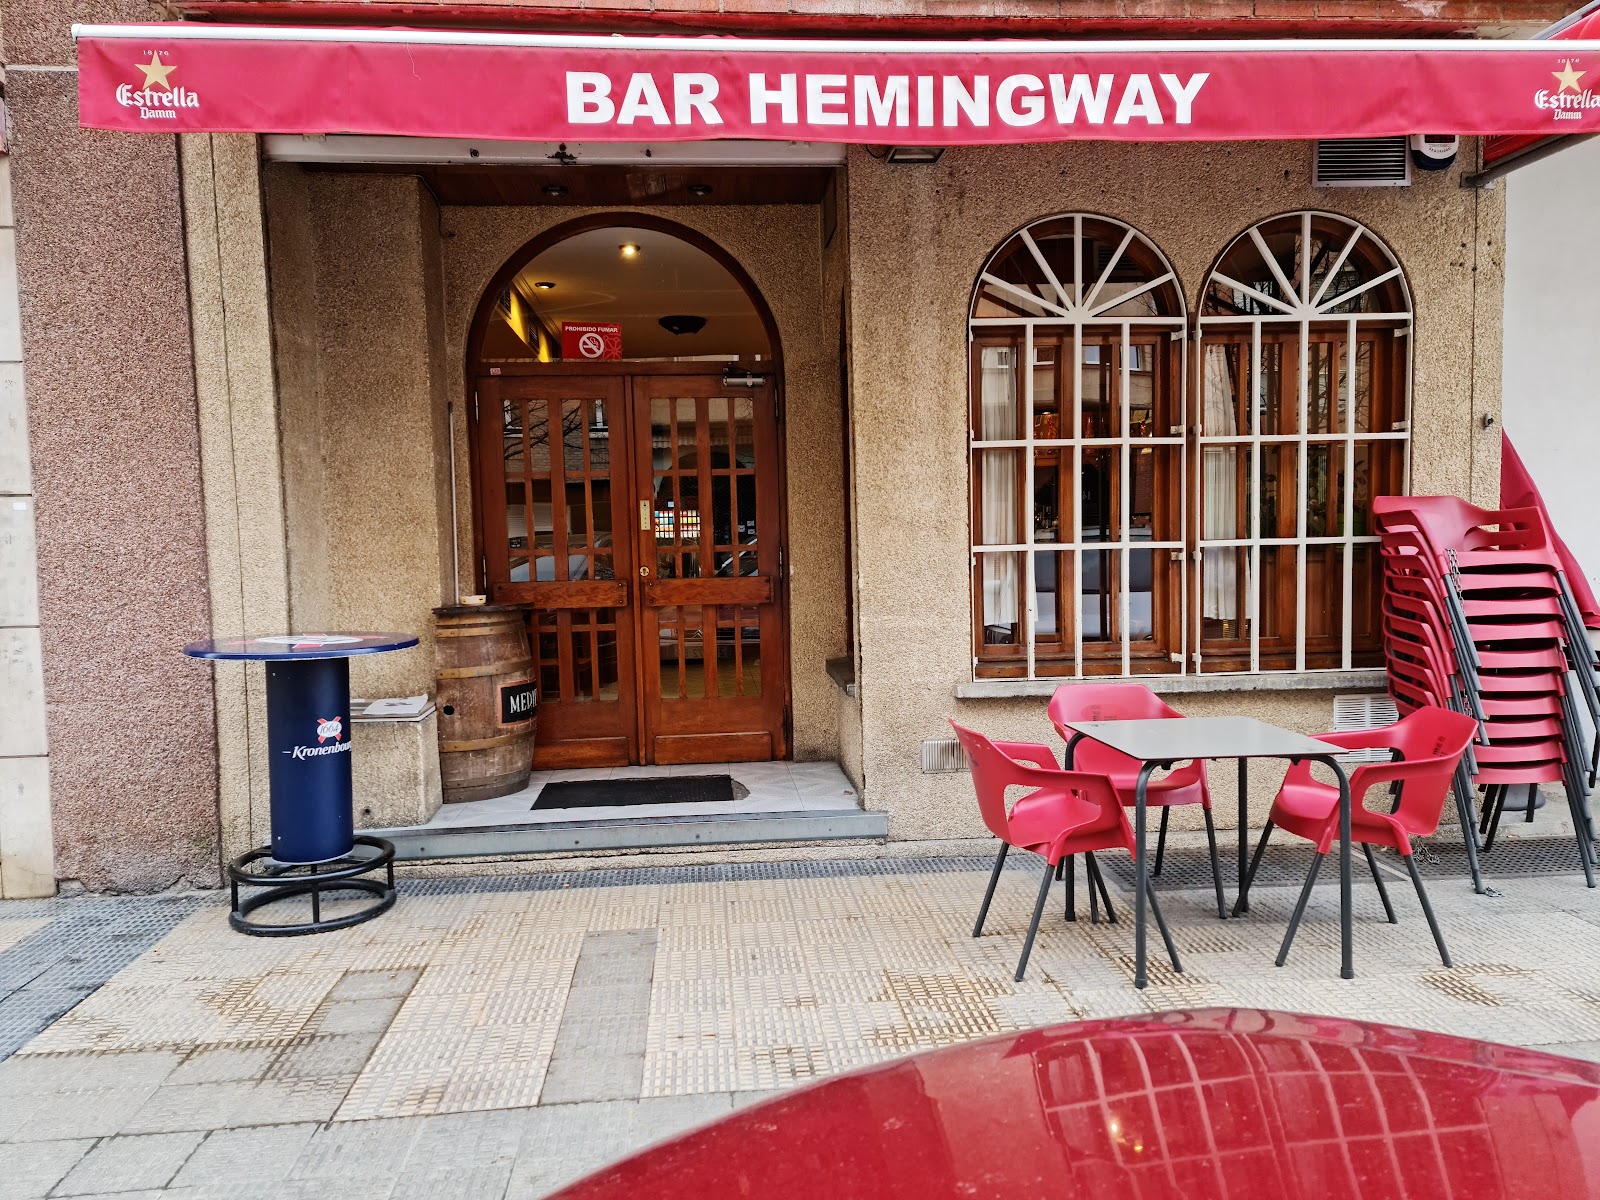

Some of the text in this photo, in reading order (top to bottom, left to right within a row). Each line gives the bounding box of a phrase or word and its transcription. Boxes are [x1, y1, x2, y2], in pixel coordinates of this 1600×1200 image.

[115, 82, 200, 108] Estrella
[566, 71, 1210, 127] BAR HEMINGWAY
[1534, 88, 1600, 110] Estrella
[139, 107, 177, 120] Damm
[1553, 109, 1583, 121] Damm
